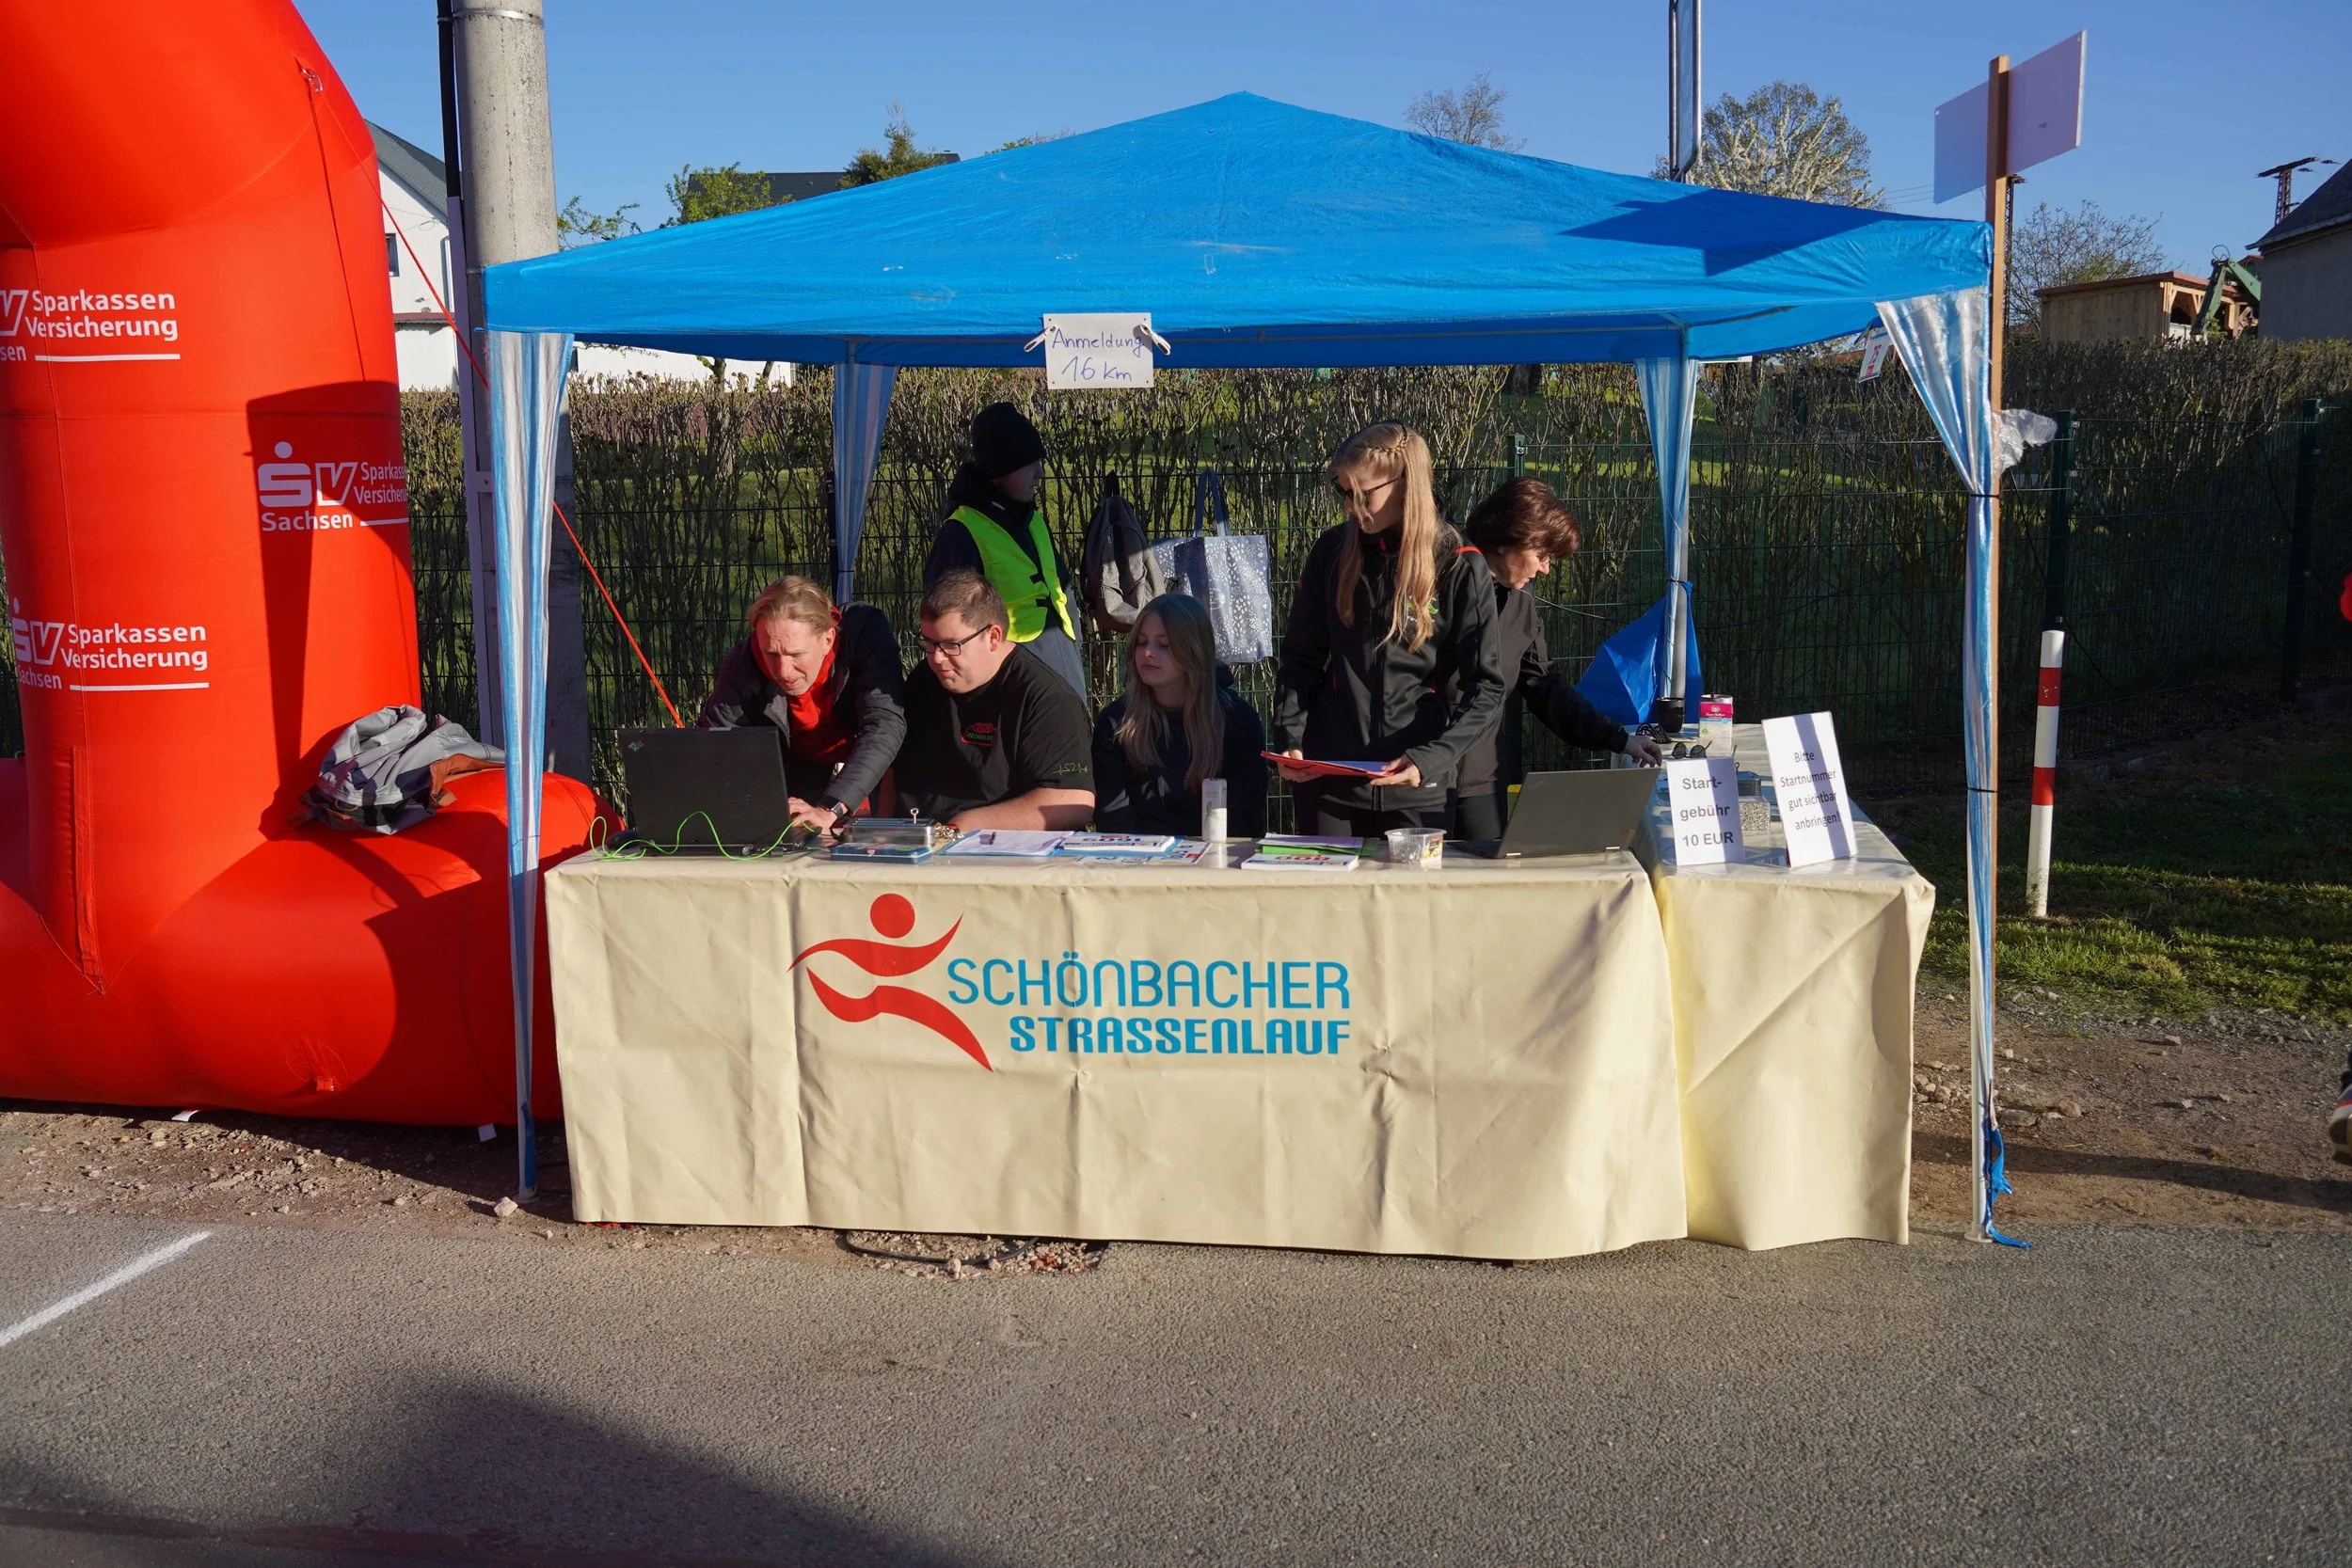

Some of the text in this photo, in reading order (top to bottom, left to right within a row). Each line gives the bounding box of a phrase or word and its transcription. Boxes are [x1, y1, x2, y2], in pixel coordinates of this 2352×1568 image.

[32, 289, 176, 317] Sparkassen
[25, 315, 179, 341] Versicherung
[1052, 328, 1144, 357] Anmeldung
[1061, 356, 1096, 382] 16
[360, 461, 406, 485] Sparkass
[262, 510, 354, 531] Sachsen
[68, 623, 207, 649] Sparkassen
[60, 647, 208, 671] Versicherung
[1794, 752, 1815, 763] Bitte
[1682, 776, 1722, 790] Start-
[1780, 770, 1836, 787] Startnummer
[1680, 803, 1730, 821] gebühr
[1788, 791, 1837, 811] gut sichtbar
[1795, 811, 1841, 830] anbringen!
[1682, 832, 1734, 847] 10 EUR
[947, 951, 1350, 1009] SCHÖNBACHER
[1009, 1016, 1350, 1055] STRASSENLAUF
